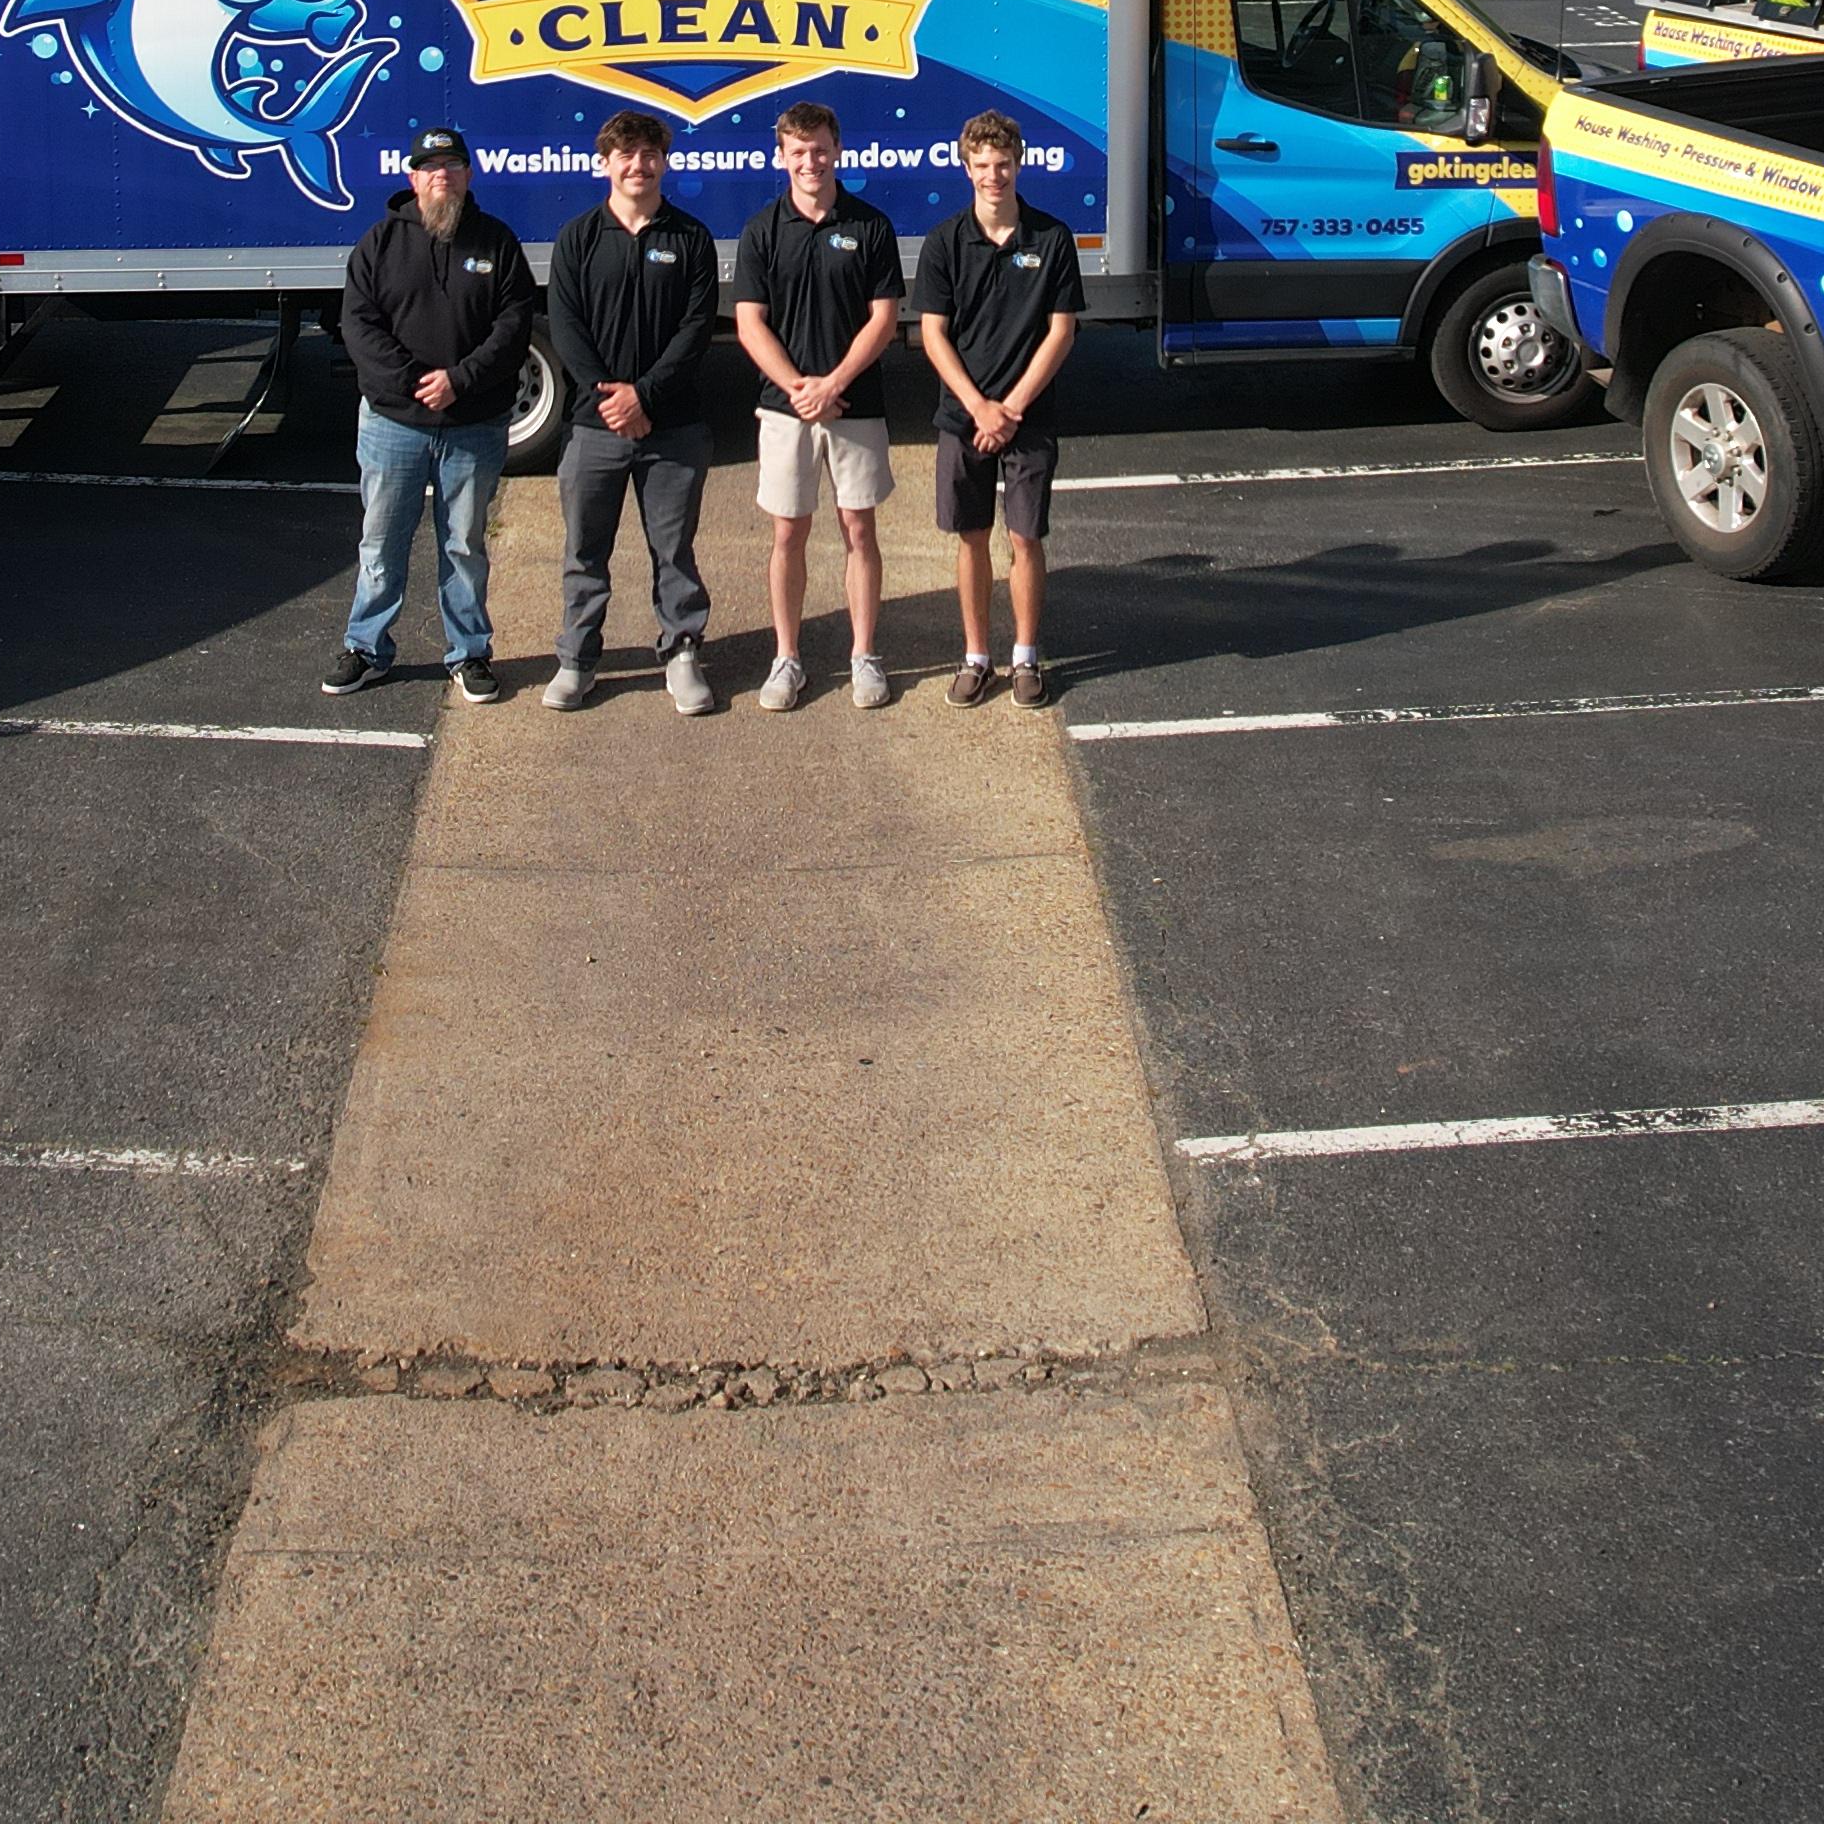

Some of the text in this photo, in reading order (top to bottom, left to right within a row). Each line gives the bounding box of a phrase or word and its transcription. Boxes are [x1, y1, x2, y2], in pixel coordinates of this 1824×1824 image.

[1654, 21, 1689, 42] House
[1691, 28, 1741, 58] Washing
[665, 148, 766, 172] essure
[929, 139, 1065, 172] Cling
[1407, 156, 1537, 185] gokingclea
[1575, 116, 1613, 139] House
[1617, 126, 1671, 158] Washing
[1681, 144, 1742, 175] Pressure
[1745, 162, 1756, 177] &
[1761, 165, 1821, 197] Window
